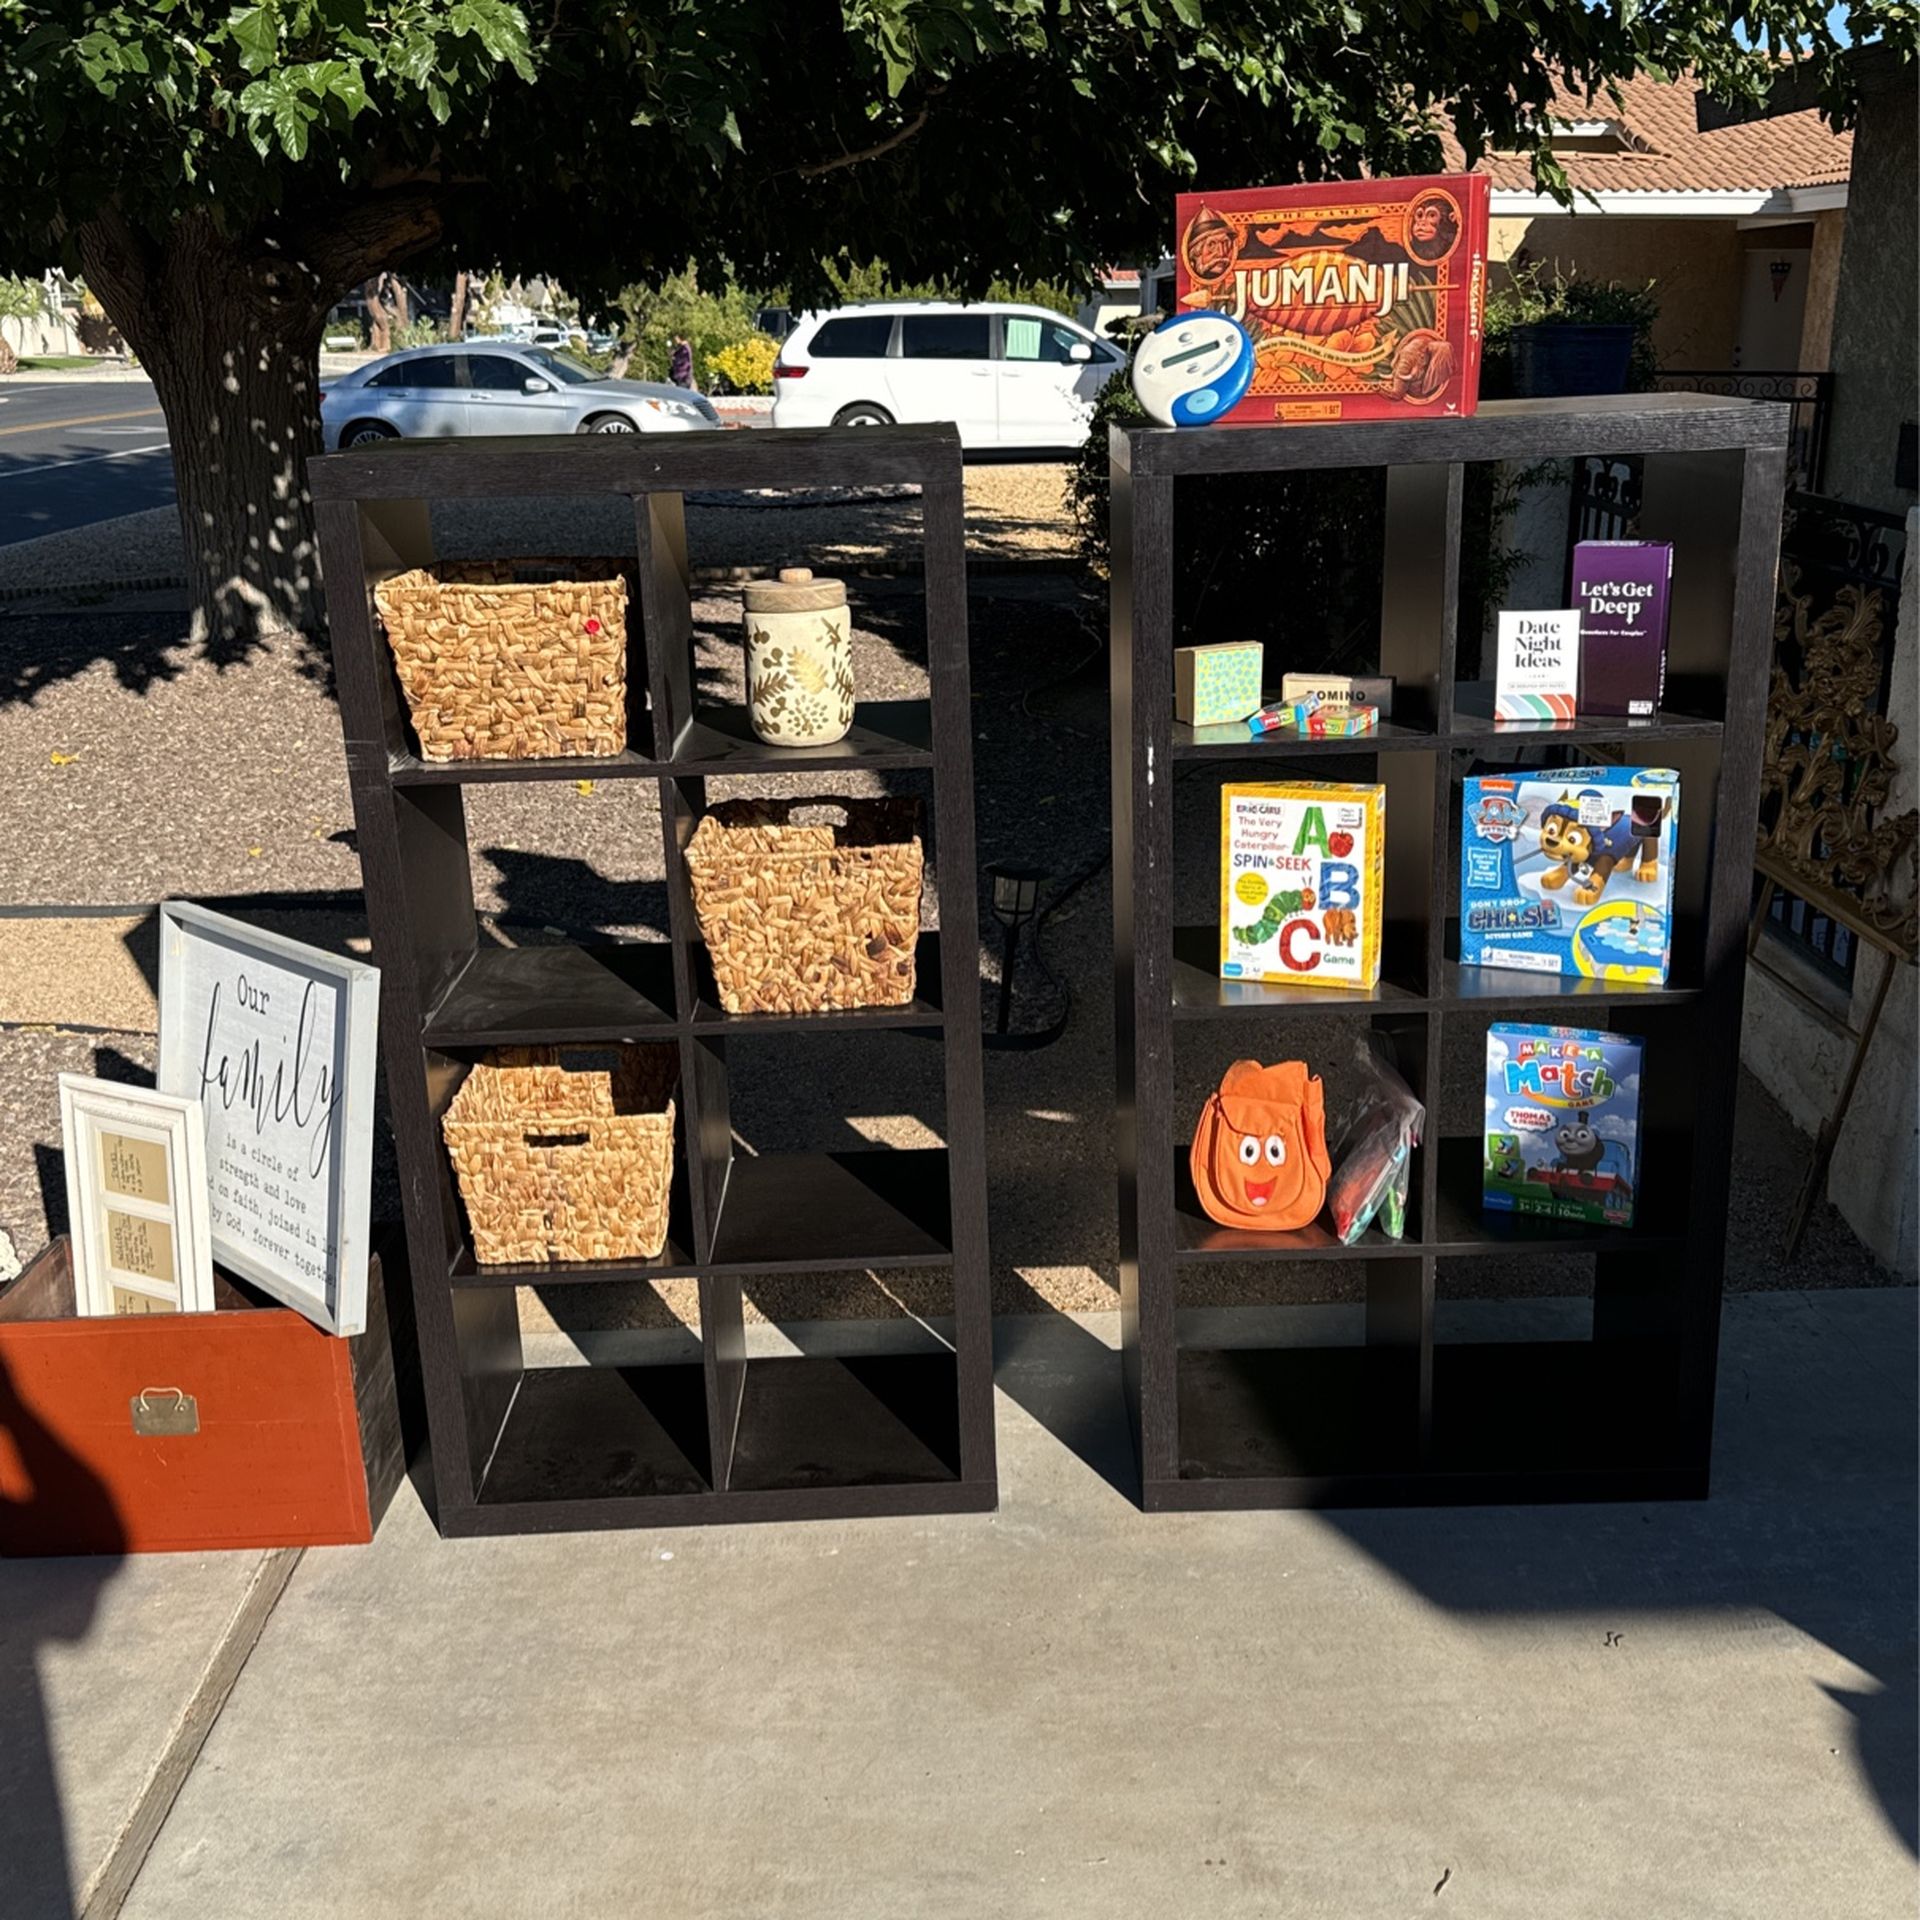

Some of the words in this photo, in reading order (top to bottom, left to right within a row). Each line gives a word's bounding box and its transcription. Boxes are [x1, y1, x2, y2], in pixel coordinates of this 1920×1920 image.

[1219, 262, 1409, 323] JUMANJI
[1580, 580, 1621, 597] Let's
[1621, 581, 1653, 597] Get
[1590, 597, 1641, 625] Deep
[1519, 620, 1560, 634] Date
[1514, 635, 1562, 655] Night
[1515, 652, 1561, 668] Ideas
[1238, 816, 1256, 826] The
[1258, 817, 1282, 829] Very
[1292, 806, 1333, 859] A
[1234, 839, 1287, 851] Caterpillar
[1241, 829, 1279, 841] Hungry
[1233, 853, 1268, 868] SPIN
[1275, 856, 1312, 871] SEEK
[1318, 861, 1360, 910] B
[1499, 899, 1527, 907] DROP
[1468, 903, 1558, 930] CHASE
[1279, 918, 1321, 972] C
[1511, 931, 1534, 939] GAME
[1323, 952, 1356, 966] Game
[238, 974, 270, 1016] Our
[199, 980, 342, 1179] family
[1504, 1059, 1615, 1099] Match
[1567, 1099, 1595, 1108] GAME
[1510, 1110, 1551, 1122] THOMAS
[226, 1132, 237, 1150] is
[240, 1143, 247, 1156] a
[251, 1147, 283, 1174] circle
[286, 1166, 299, 1182] of
[219, 1157, 259, 1190] strength
[263, 1181, 280, 1200] and
[284, 1189, 307, 1214] love
[218, 1184, 229, 1199] on
[233, 1188, 263, 1220] faith,
[268, 1208, 300, 1239] joined
[305, 1228, 317, 1248] in
[1535, 1204, 1552, 1215] 2-4
[211, 1202, 223, 1223] by
[226, 1209, 246, 1238] God,
[252, 1227, 290, 1260] forever
